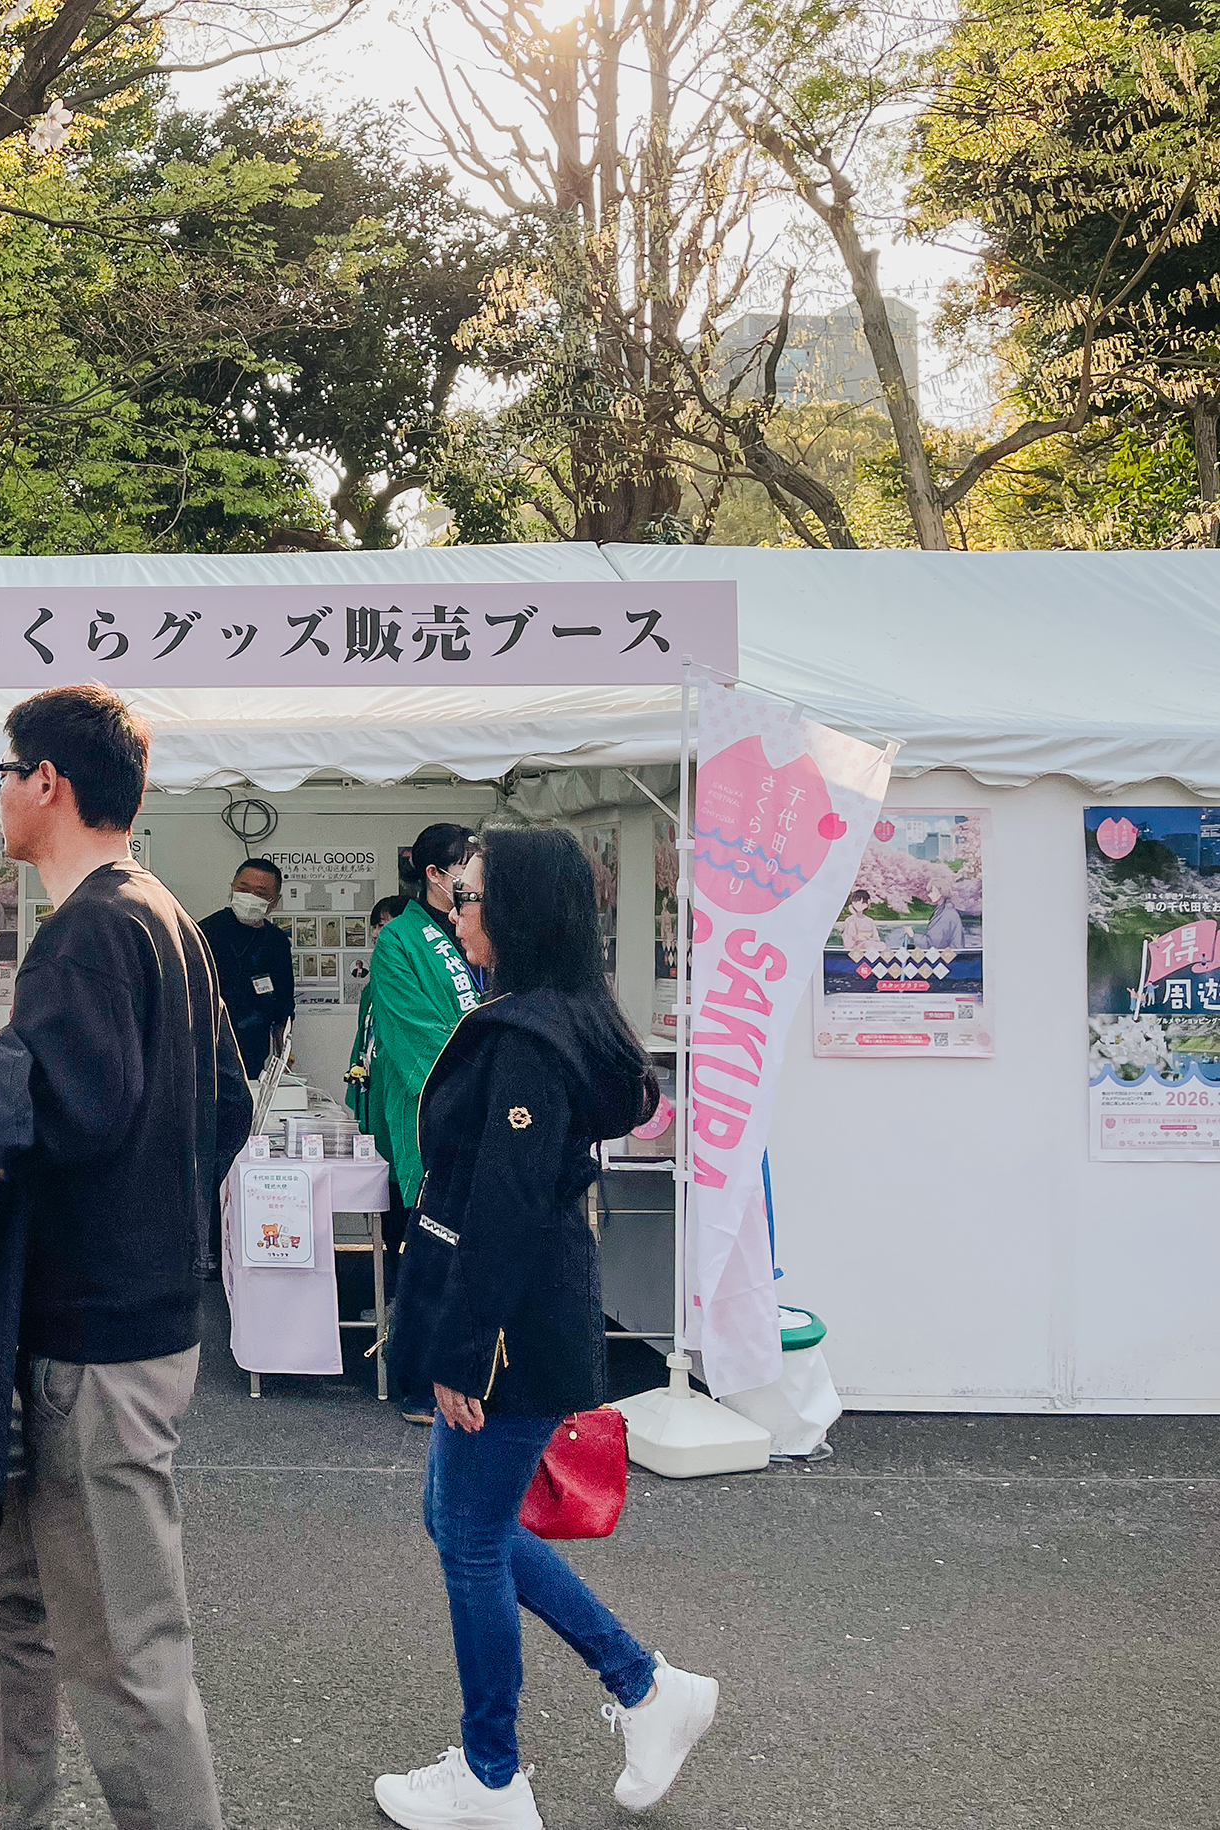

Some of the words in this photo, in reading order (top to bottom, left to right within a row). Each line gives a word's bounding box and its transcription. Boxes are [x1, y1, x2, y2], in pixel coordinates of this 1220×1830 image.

[261, 852, 321, 864] OFFICIAL
[323, 852, 375, 864] GOODS
[728, 774, 776, 895] さくらまつり
[765, 784, 807, 875] 千代田の
[433, 939, 481, 1012] 千代田区
[1162, 926, 1199, 968] 得
[1165, 1091, 1220, 1107] 2026.
